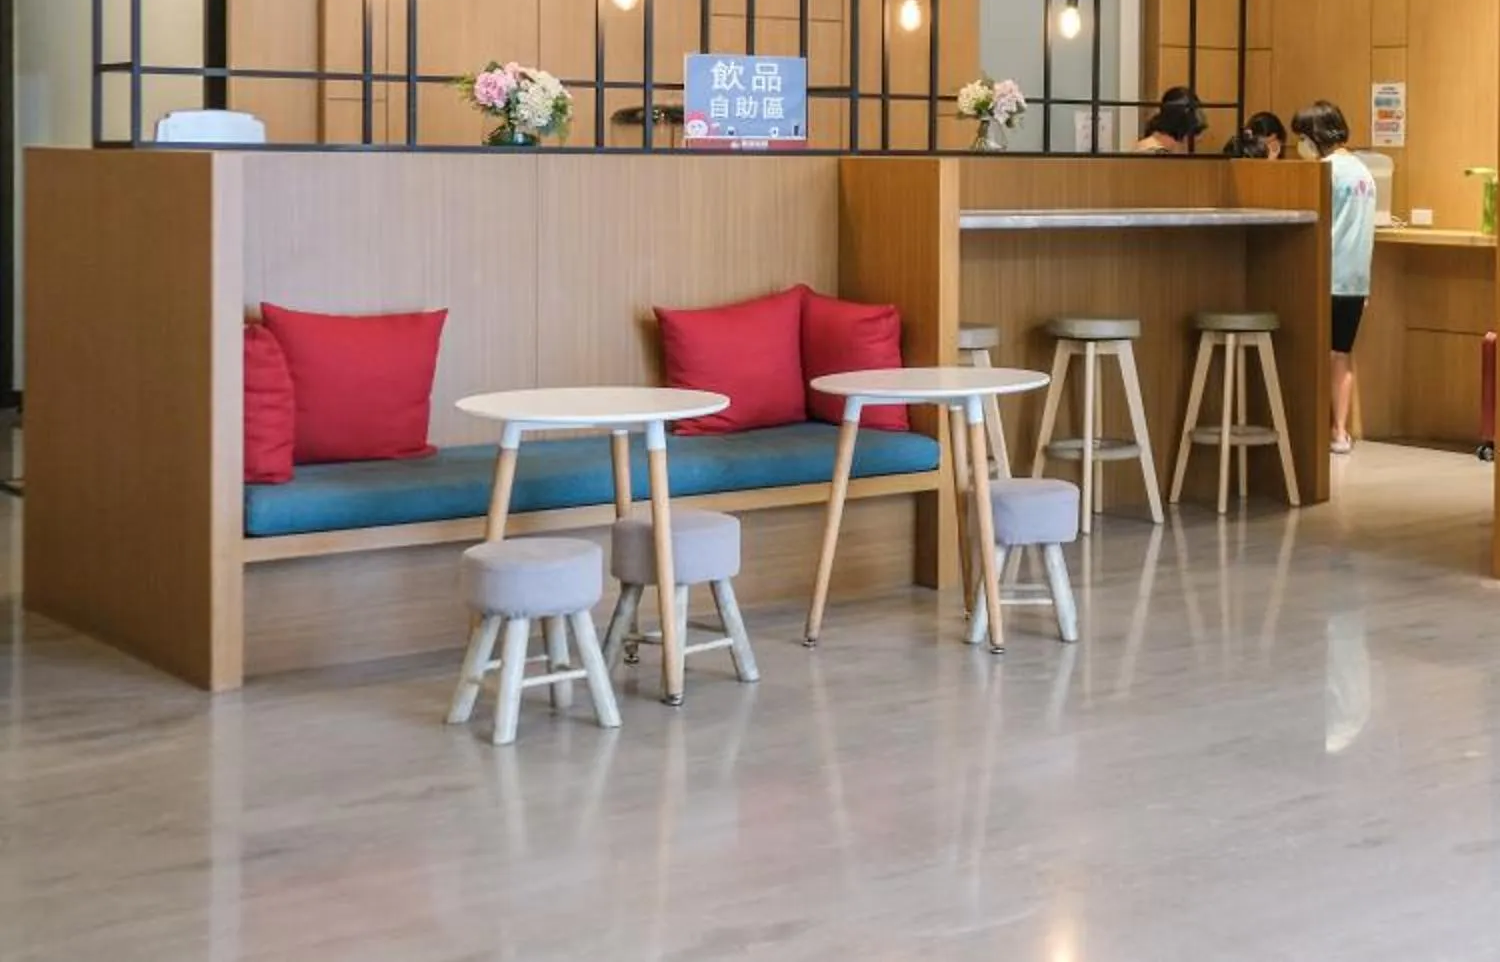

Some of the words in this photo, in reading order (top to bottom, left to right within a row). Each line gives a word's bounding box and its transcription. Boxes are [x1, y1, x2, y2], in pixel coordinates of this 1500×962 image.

[711, 59, 782, 92] 飲品
[710, 94, 785, 119] 自助區
